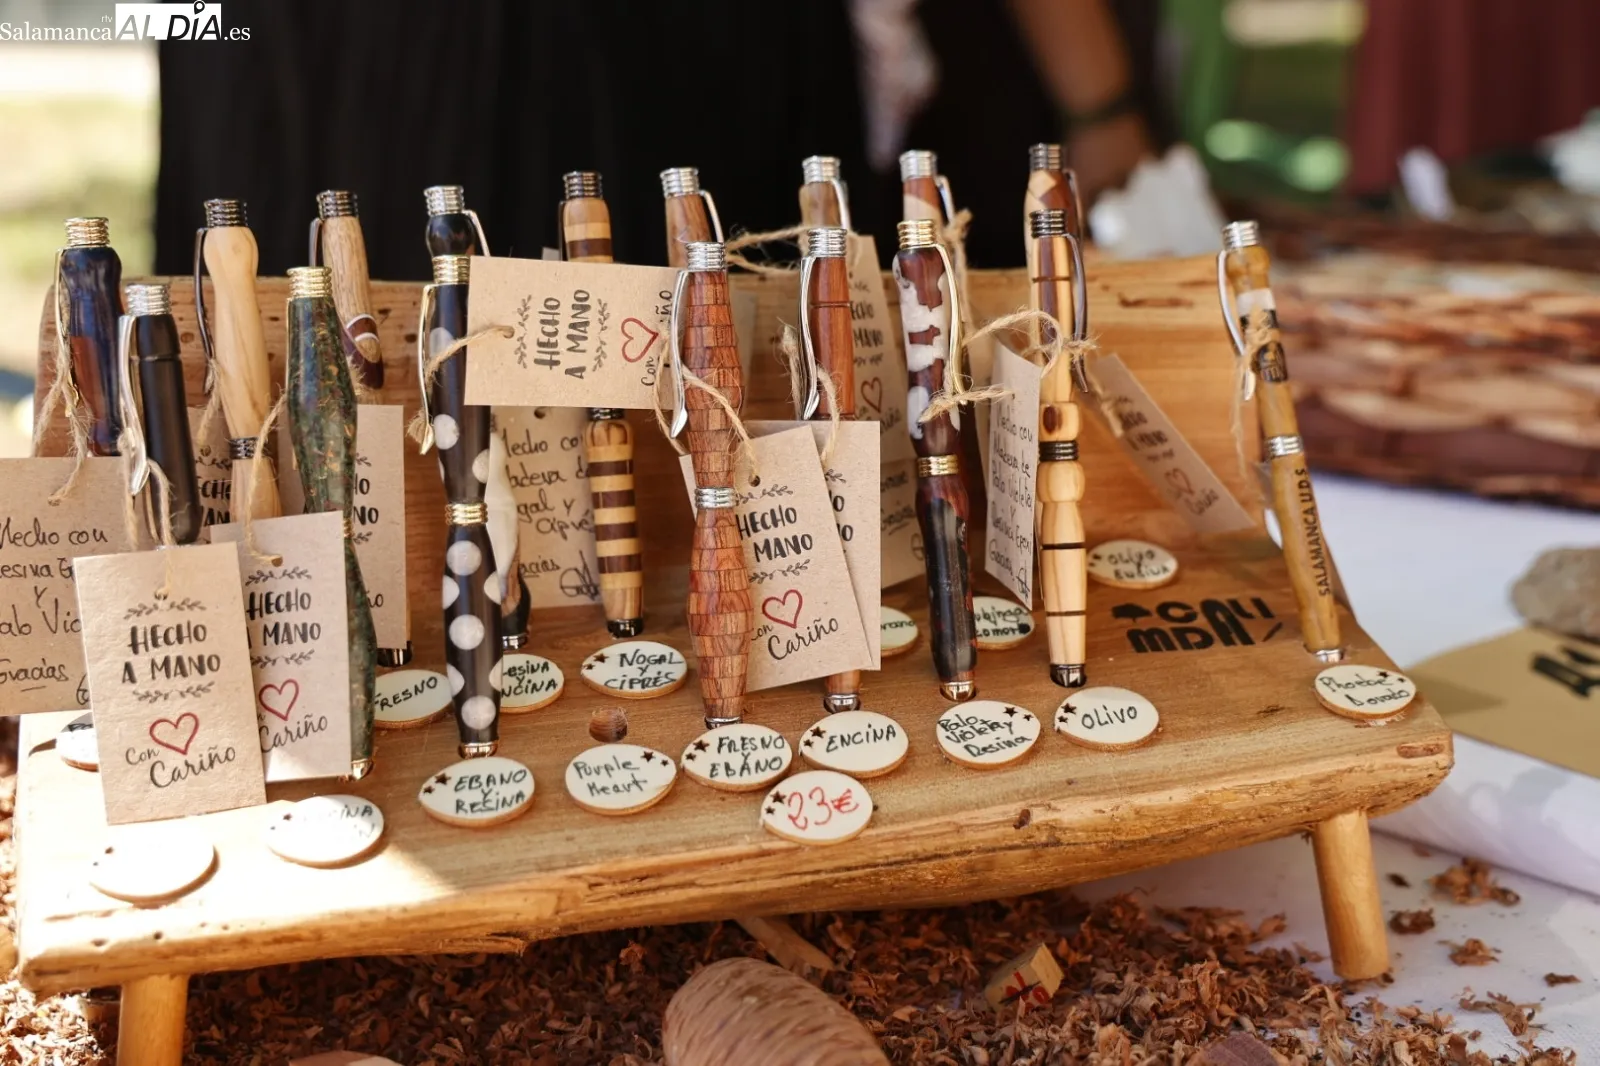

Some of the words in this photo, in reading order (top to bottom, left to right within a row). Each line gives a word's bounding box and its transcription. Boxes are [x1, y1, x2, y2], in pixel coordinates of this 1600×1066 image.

[534, 297, 561, 370] HECHO
[566, 289, 592, 353] MANO
[565, 366, 587, 380] A
[735, 504, 798, 541] HECHO
[753, 533, 814, 563] MANO
[1302, 505, 1331, 597] SALAMANCA
[246, 587, 312, 621] HECHO
[128, 623, 208, 655] HECHO
[263, 622, 322, 646] MANO
[767, 616, 839, 661] Cariño
[121, 660, 138, 684] A
[151, 653, 222, 682] MANO
[618, 648, 684, 668] NOGAL
[258, 714, 328, 753] Cariño
[716, 734, 786, 755] FRESNO
[125, 746, 160, 766] Con
[149, 745, 237, 788] Cariño
[453, 768, 528, 793] EBANO
[788, 786, 860, 830] 23€
